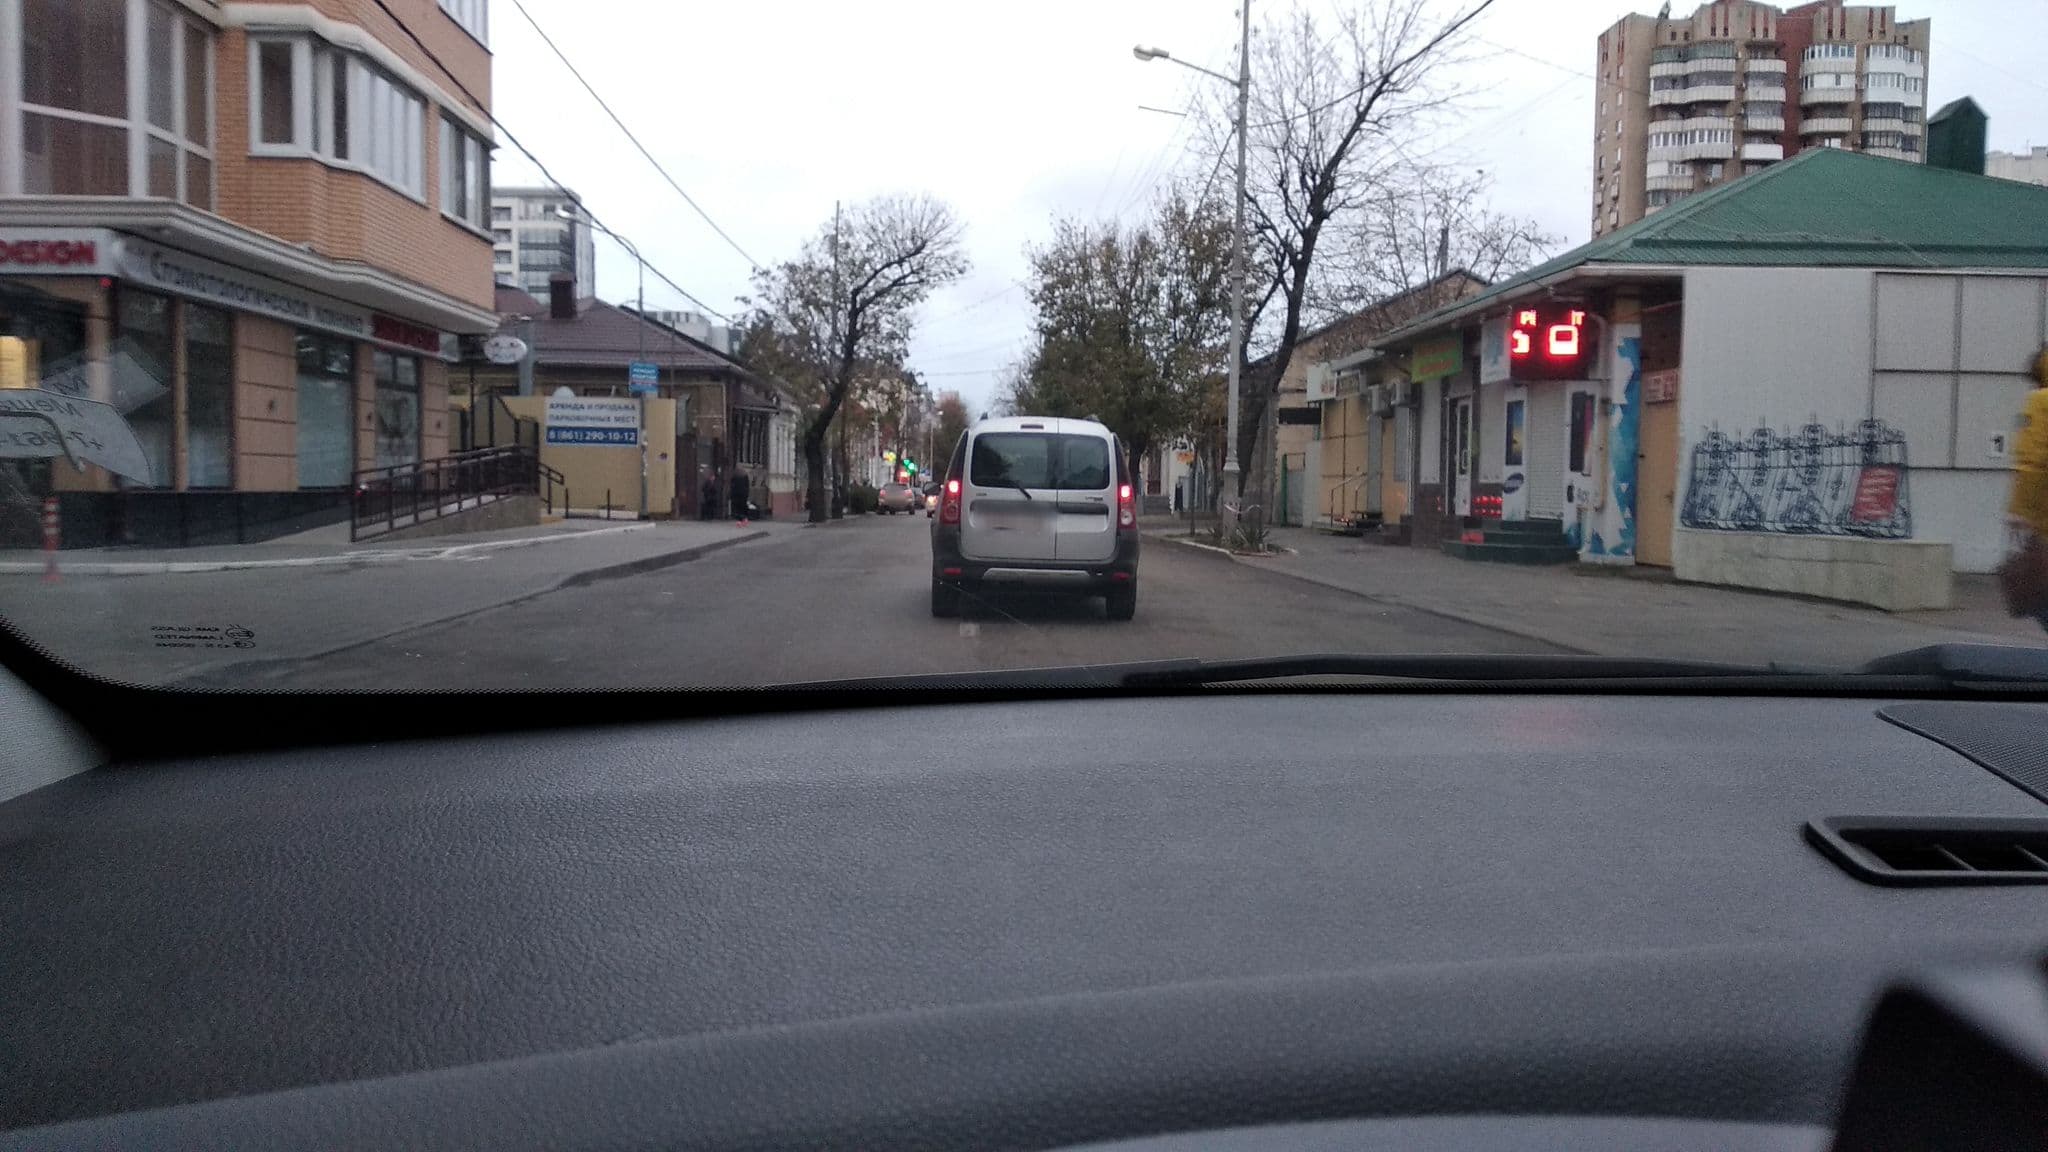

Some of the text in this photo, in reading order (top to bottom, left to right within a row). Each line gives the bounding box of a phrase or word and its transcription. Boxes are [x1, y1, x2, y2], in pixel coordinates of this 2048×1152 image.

[549, 402, 585, 410] АРЕНДА
[613, 416, 636, 424] МЕСТ
[585, 431, 637, 441] 290-10-12
